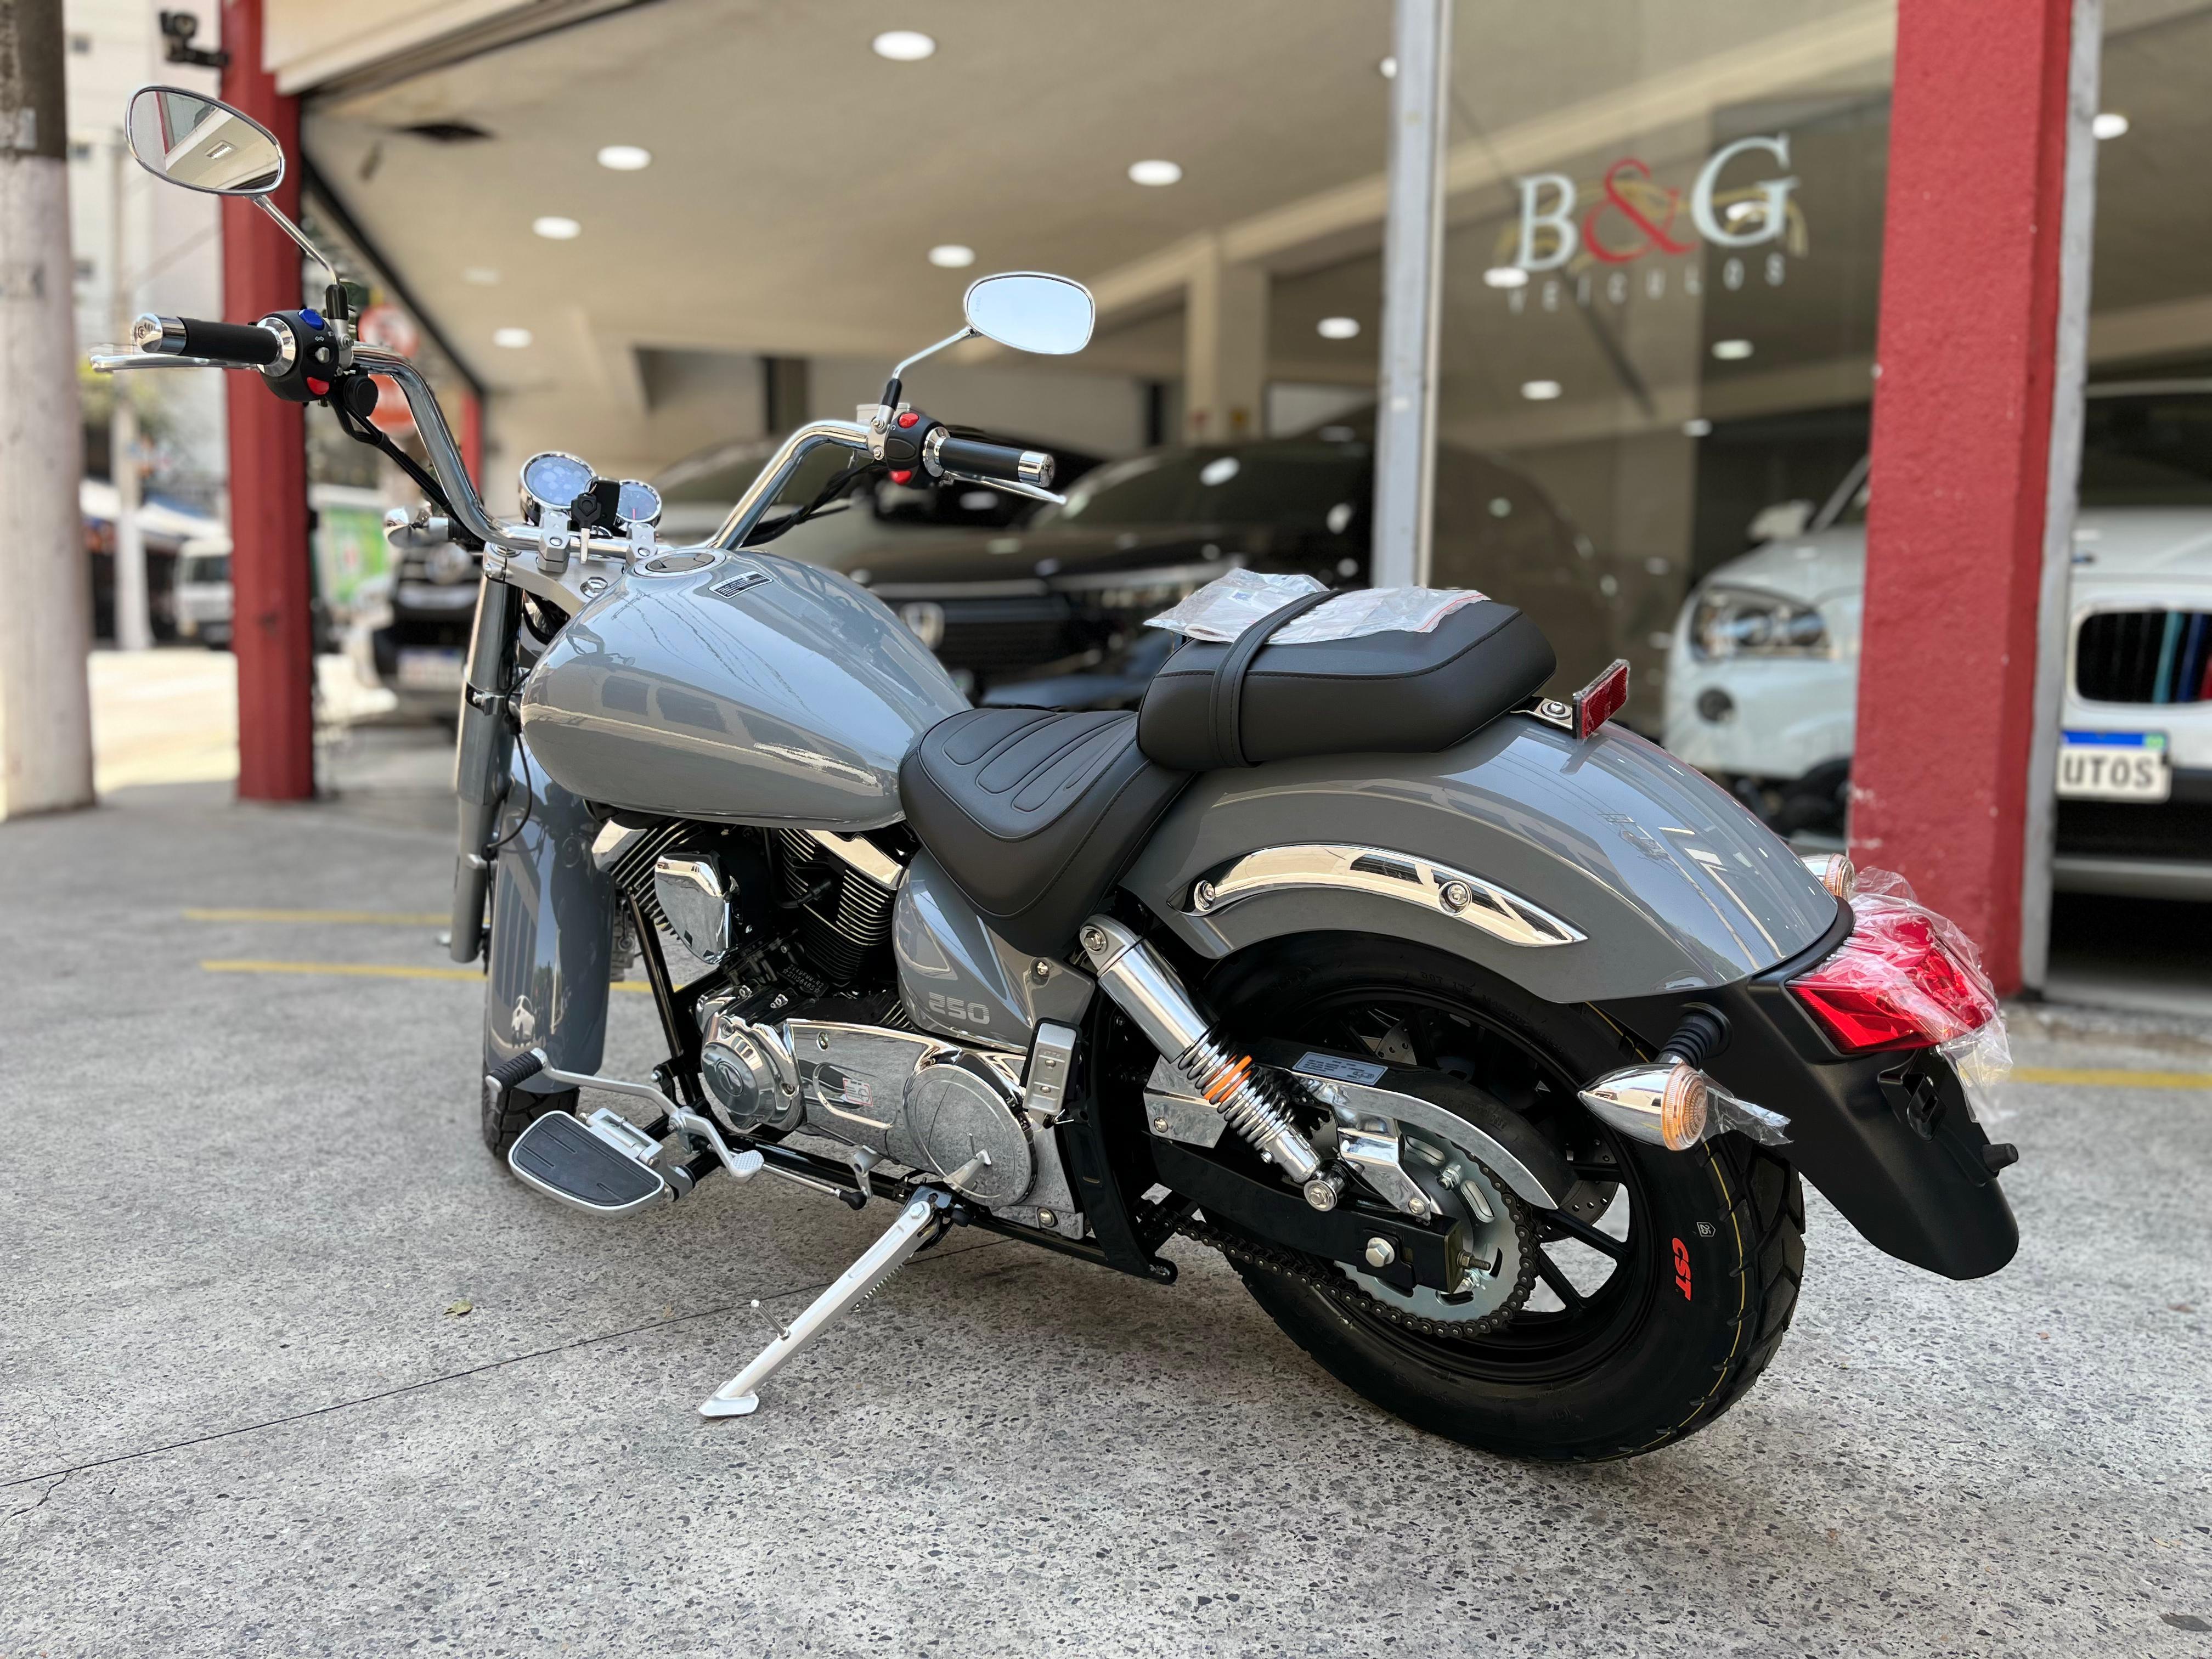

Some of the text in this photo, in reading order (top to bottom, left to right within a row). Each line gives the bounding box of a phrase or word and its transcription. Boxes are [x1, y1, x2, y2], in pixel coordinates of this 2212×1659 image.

[1513, 133, 1799, 272] B&G
[929, 991, 991, 1025] 250
[1672, 1237, 1691, 1302] CST
